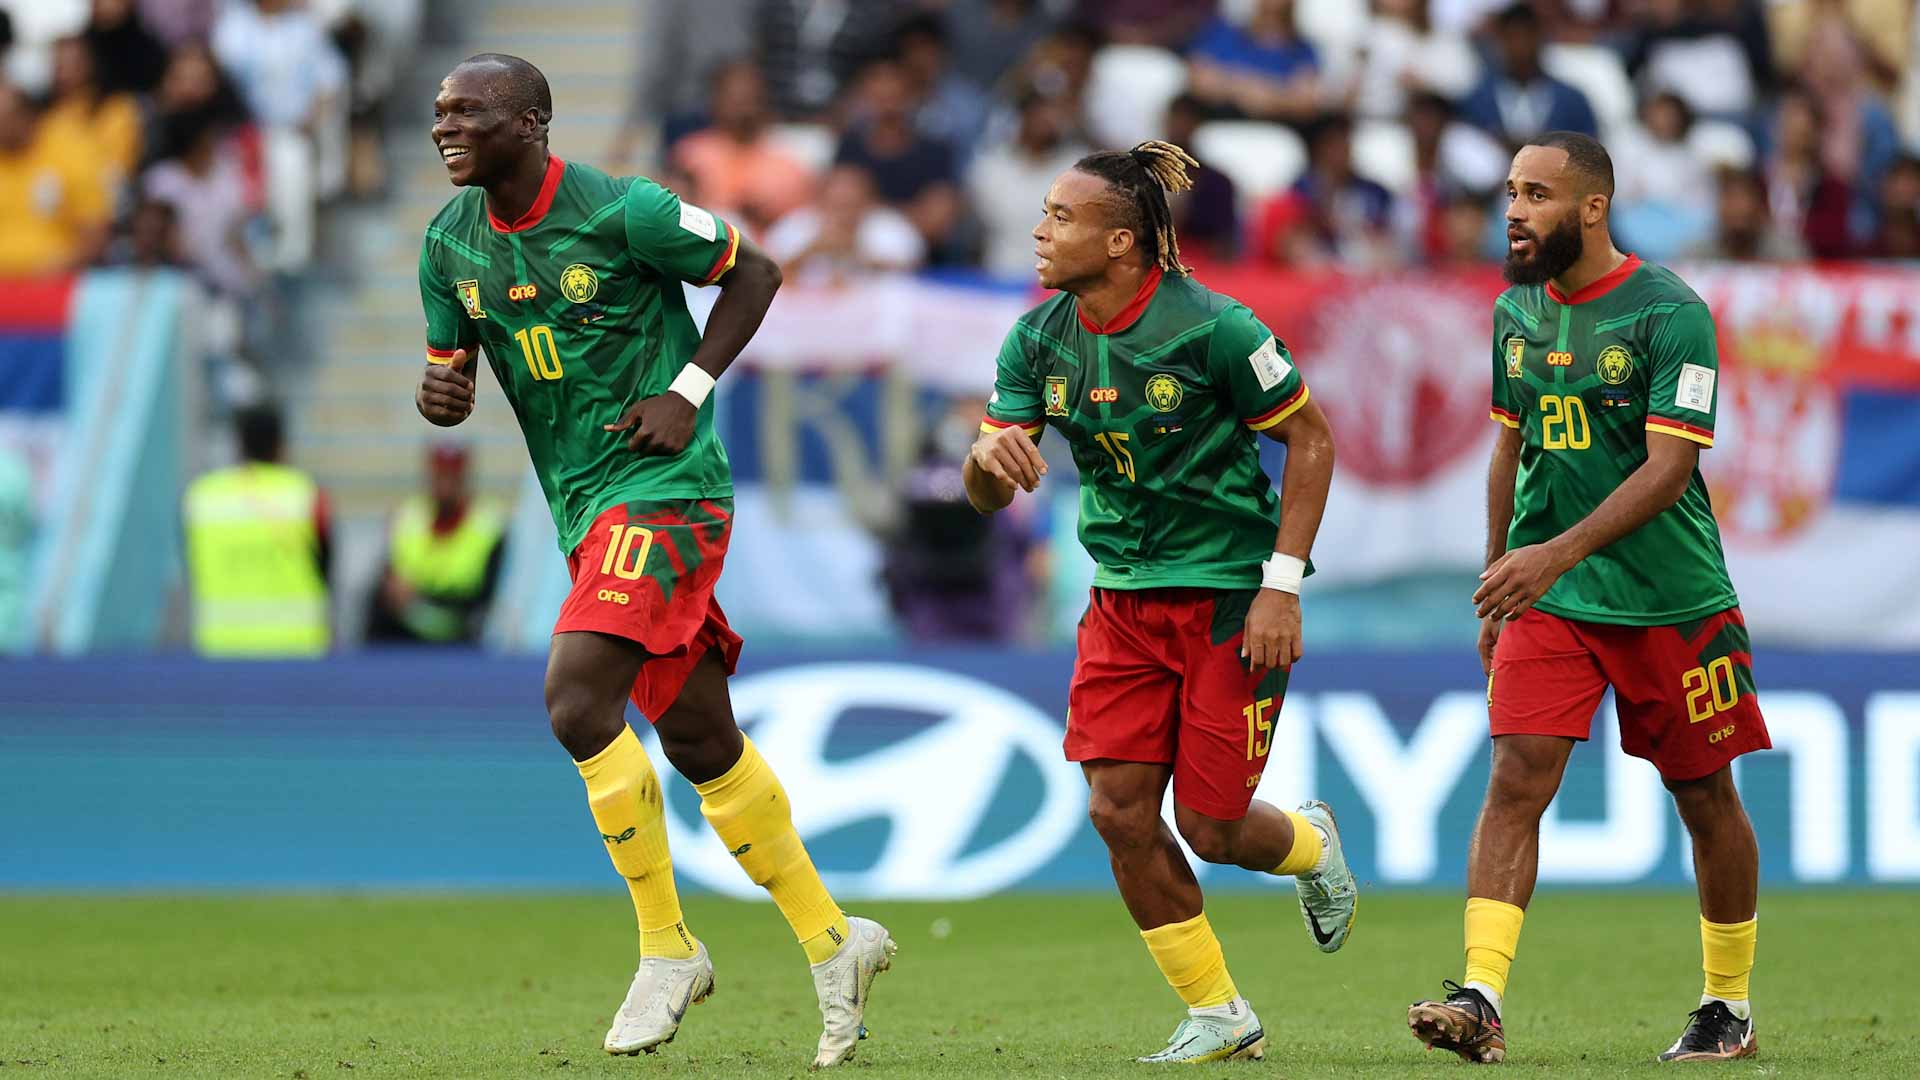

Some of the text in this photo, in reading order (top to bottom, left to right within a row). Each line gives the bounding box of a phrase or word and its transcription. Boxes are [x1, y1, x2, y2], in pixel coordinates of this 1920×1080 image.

[509, 285, 536, 302] one
[515, 326, 564, 381] 10
[1547, 352, 1573, 366] one
[1091, 388, 1118, 404] one
[1540, 395, 1591, 450] 20
[1095, 431, 1136, 483] 15
[601, 524, 654, 581] 10
[598, 588, 630, 605] one
[1682, 656, 1738, 724] 20
[1243, 698, 1273, 761] 15
[1709, 725, 1735, 744] one
